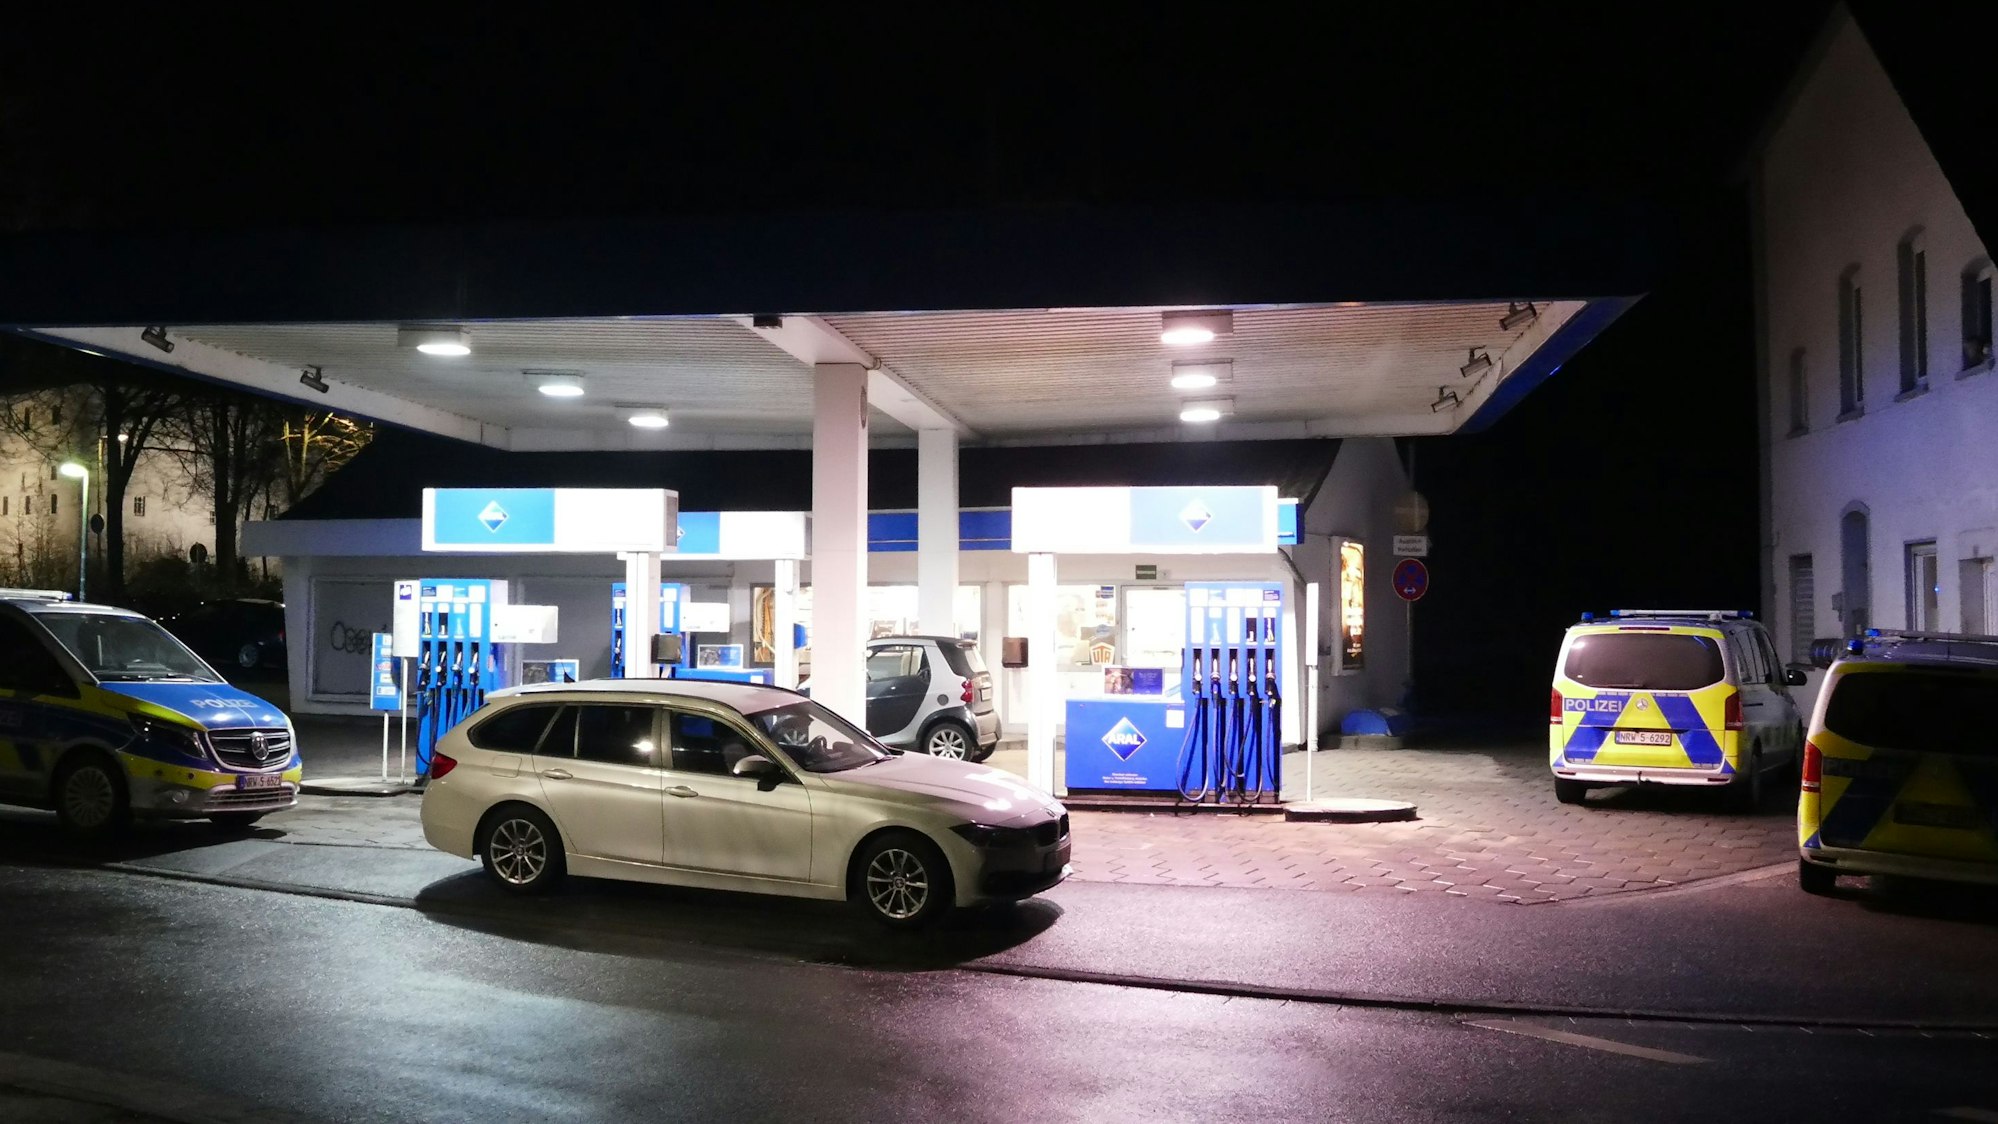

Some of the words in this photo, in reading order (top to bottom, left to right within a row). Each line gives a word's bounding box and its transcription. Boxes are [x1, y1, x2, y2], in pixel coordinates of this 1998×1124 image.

[1092, 645, 1112, 663] UTA
[190, 698, 259, 709] POLIZEI
[1565, 699, 1622, 712] POLIZEI
[1107, 733, 1141, 746] ARAL
[1620, 733, 1636, 742] NRW
